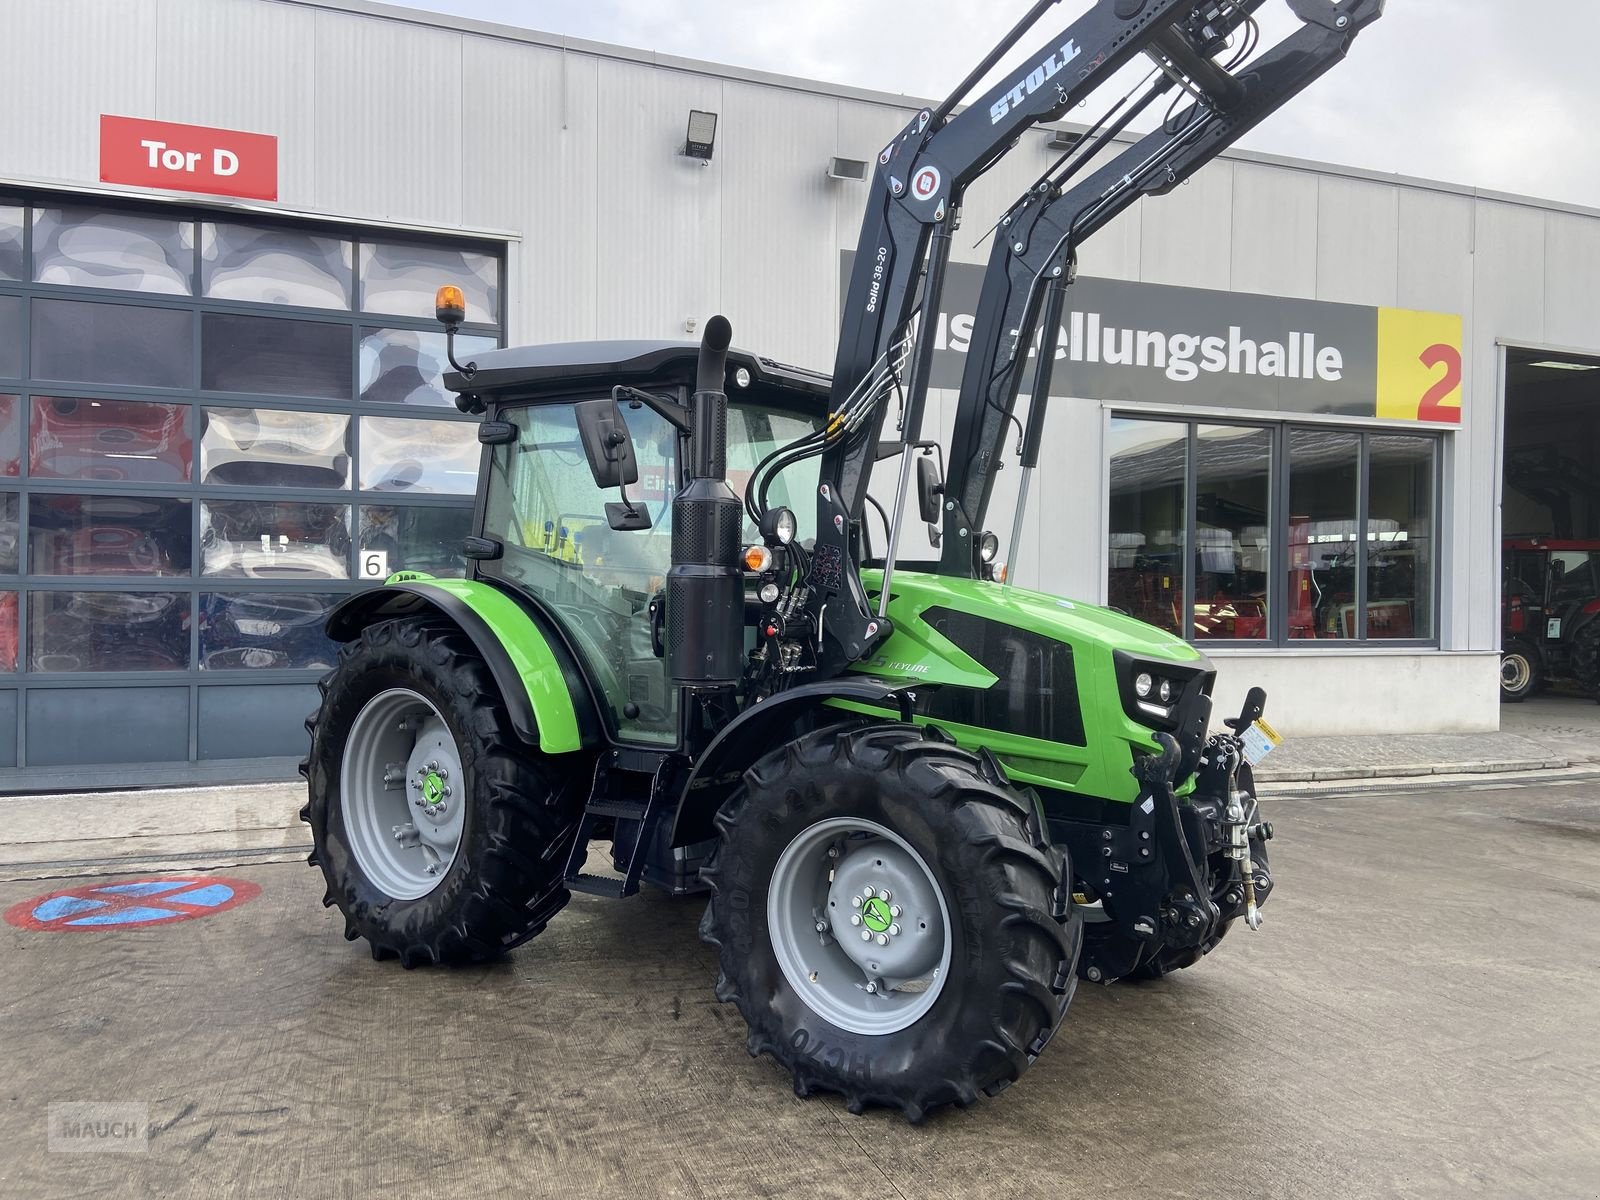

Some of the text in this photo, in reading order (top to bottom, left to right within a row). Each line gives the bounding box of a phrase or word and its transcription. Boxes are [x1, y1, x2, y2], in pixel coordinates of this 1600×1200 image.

[989, 38, 1081, 125] STOLL
[141, 139, 239, 176] Tor D
[866, 246, 887, 313] Solid 38-20
[1416, 343, 1461, 424] 2
[365, 554, 381, 577] 6
